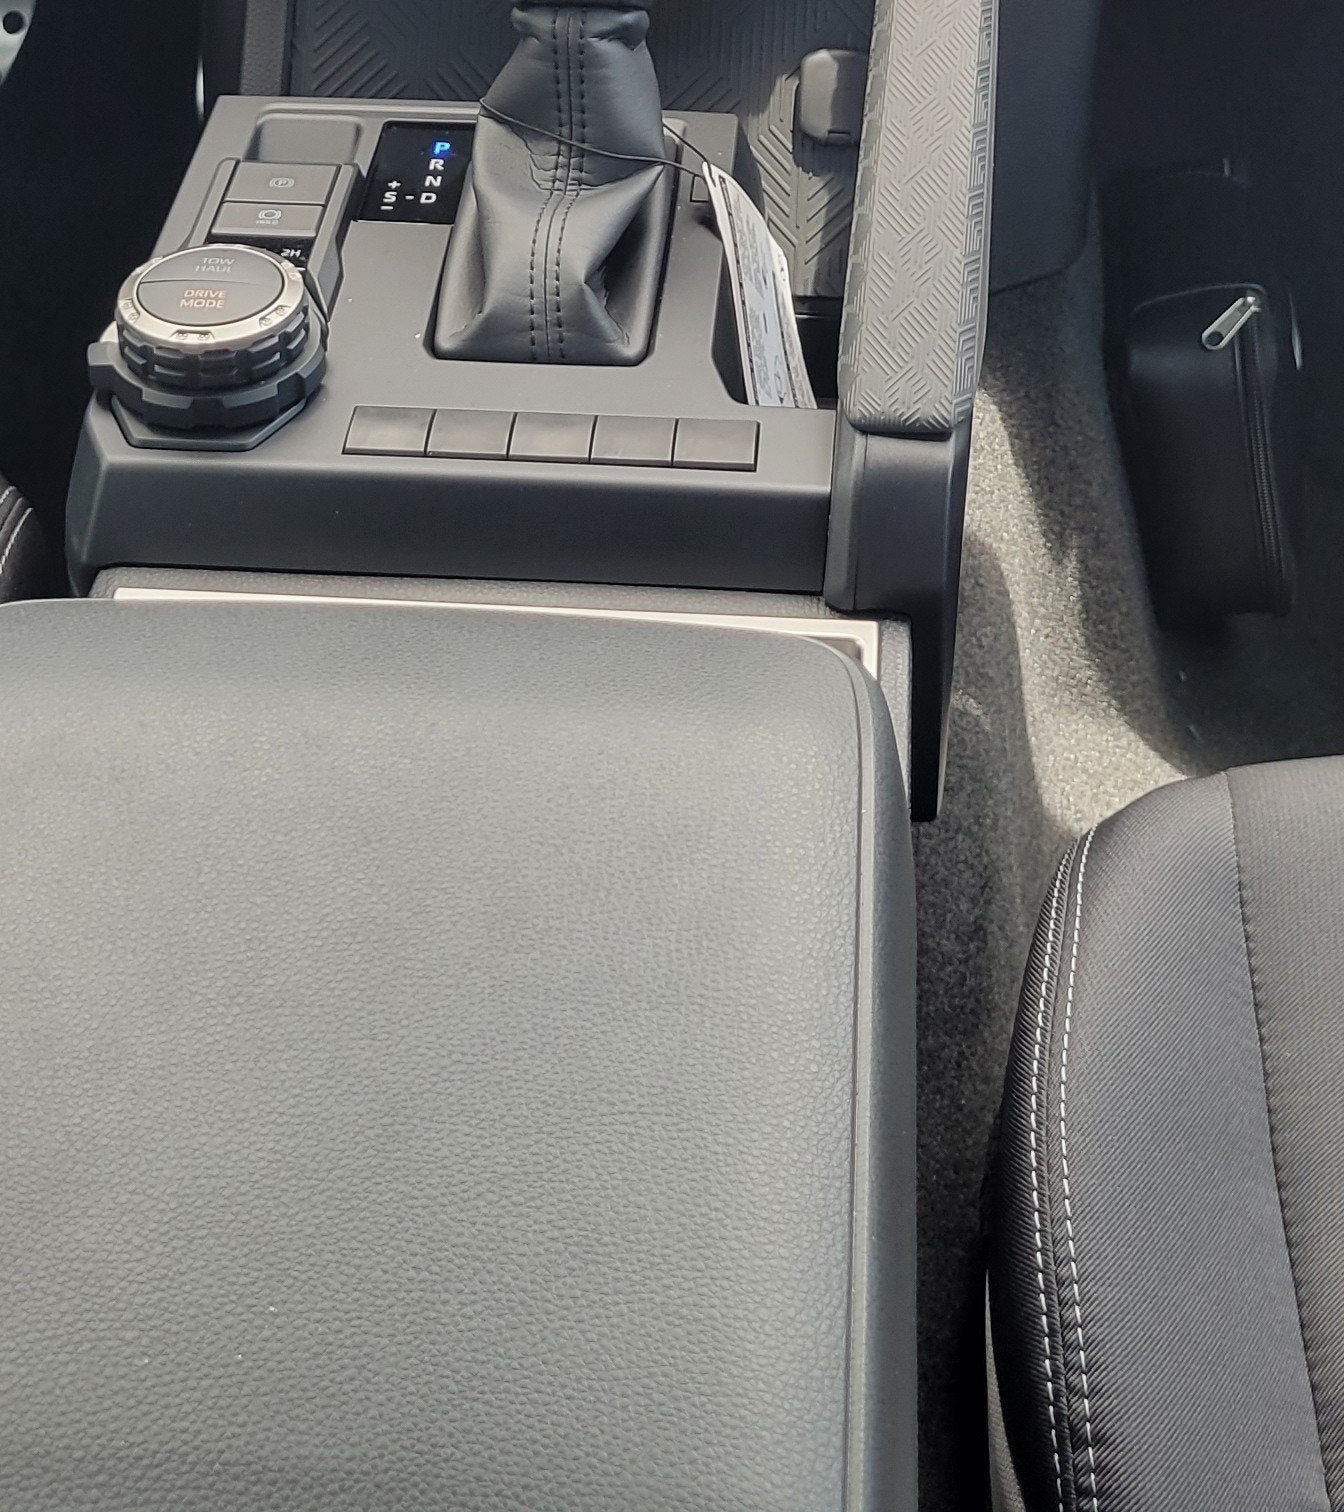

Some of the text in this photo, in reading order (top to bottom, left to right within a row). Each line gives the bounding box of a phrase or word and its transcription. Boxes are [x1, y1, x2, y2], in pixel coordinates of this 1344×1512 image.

[434, 141, 451, 155] P
[428, 158, 445, 171] R
[424, 175, 442, 187] N
[382, 191, 437, 204] S D
[280, 248, 302, 257] 2H
[202, 257, 236, 265] TOW
[184, 289, 227, 299] DRIVE
[180, 299, 225, 308] MODE
